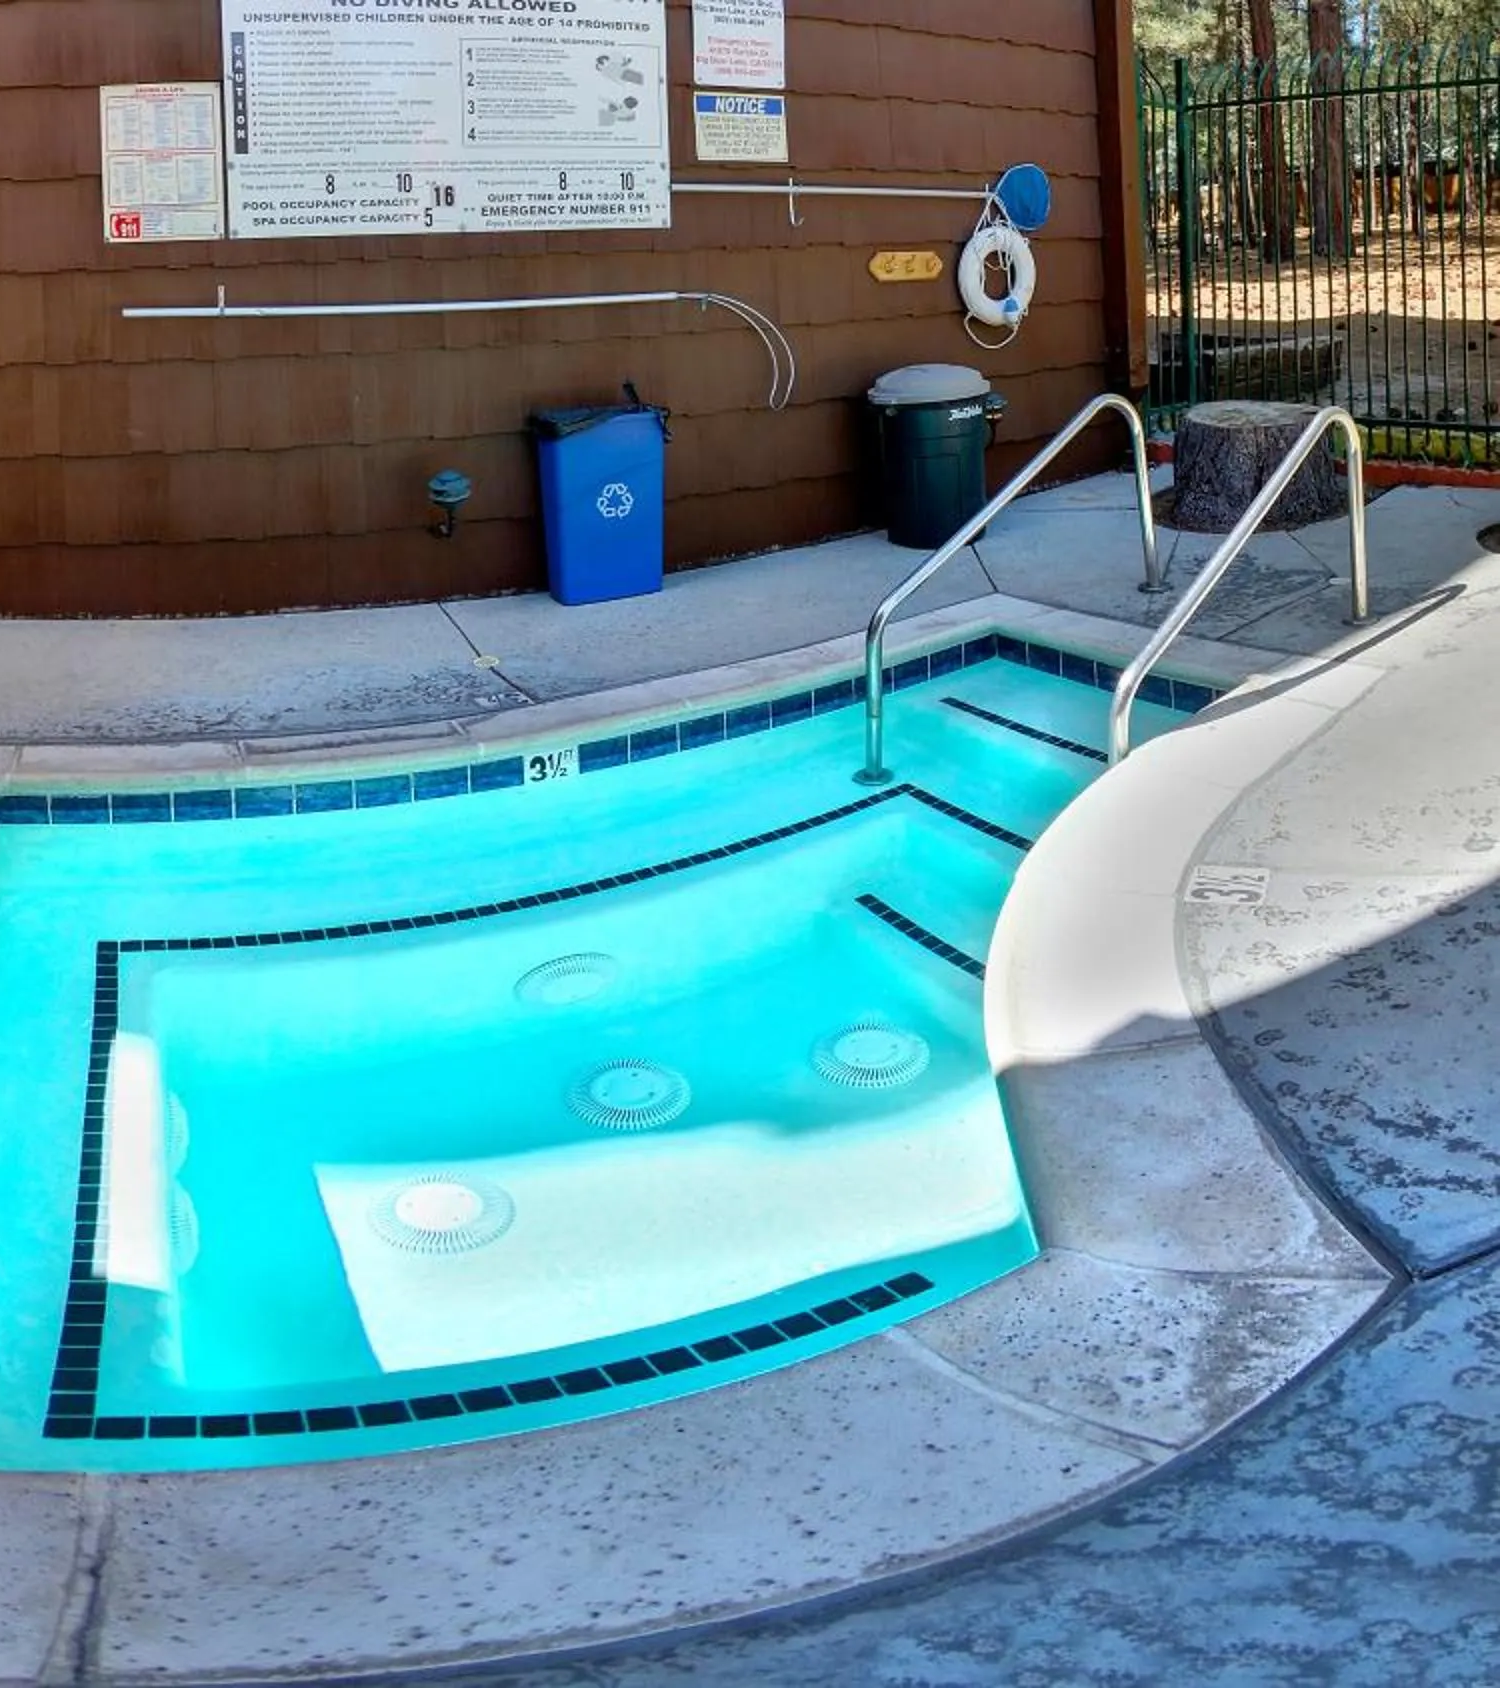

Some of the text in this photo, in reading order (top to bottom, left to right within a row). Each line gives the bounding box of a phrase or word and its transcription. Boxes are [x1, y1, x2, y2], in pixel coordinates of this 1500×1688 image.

[375, 0, 459, 9] DIVING
[467, 0, 577, 13] ALLOWED
[243, 13, 650, 32] UNSUPERVISED CHILDREN UNDER THE AGE OF 14 PROHIBITED
[466, 48, 473, 61] 1
[467, 72, 475, 87] 2
[233, 45, 246, 139] CAUTION
[467, 100, 475, 114] 3
[715, 96, 767, 113] NOTICE
[467, 128, 476, 141] 4
[325, 174, 336, 195] 8
[396, 173, 413, 193] 10
[559, 171, 568, 191] 8
[620, 171, 635, 191] 10
[242, 185, 455, 211] POOL OCCUPANCY CAPACITY 16
[487, 192, 523, 202] QUIET
[525, 192, 554, 202] TIME
[558, 192, 593, 201] AFTER
[253, 207, 434, 227] SPA OCCUPANCY CAPACITY 5
[481, 203, 651, 217] EMERGENCY NUMBER 911
[120, 222, 137, 237] 911
